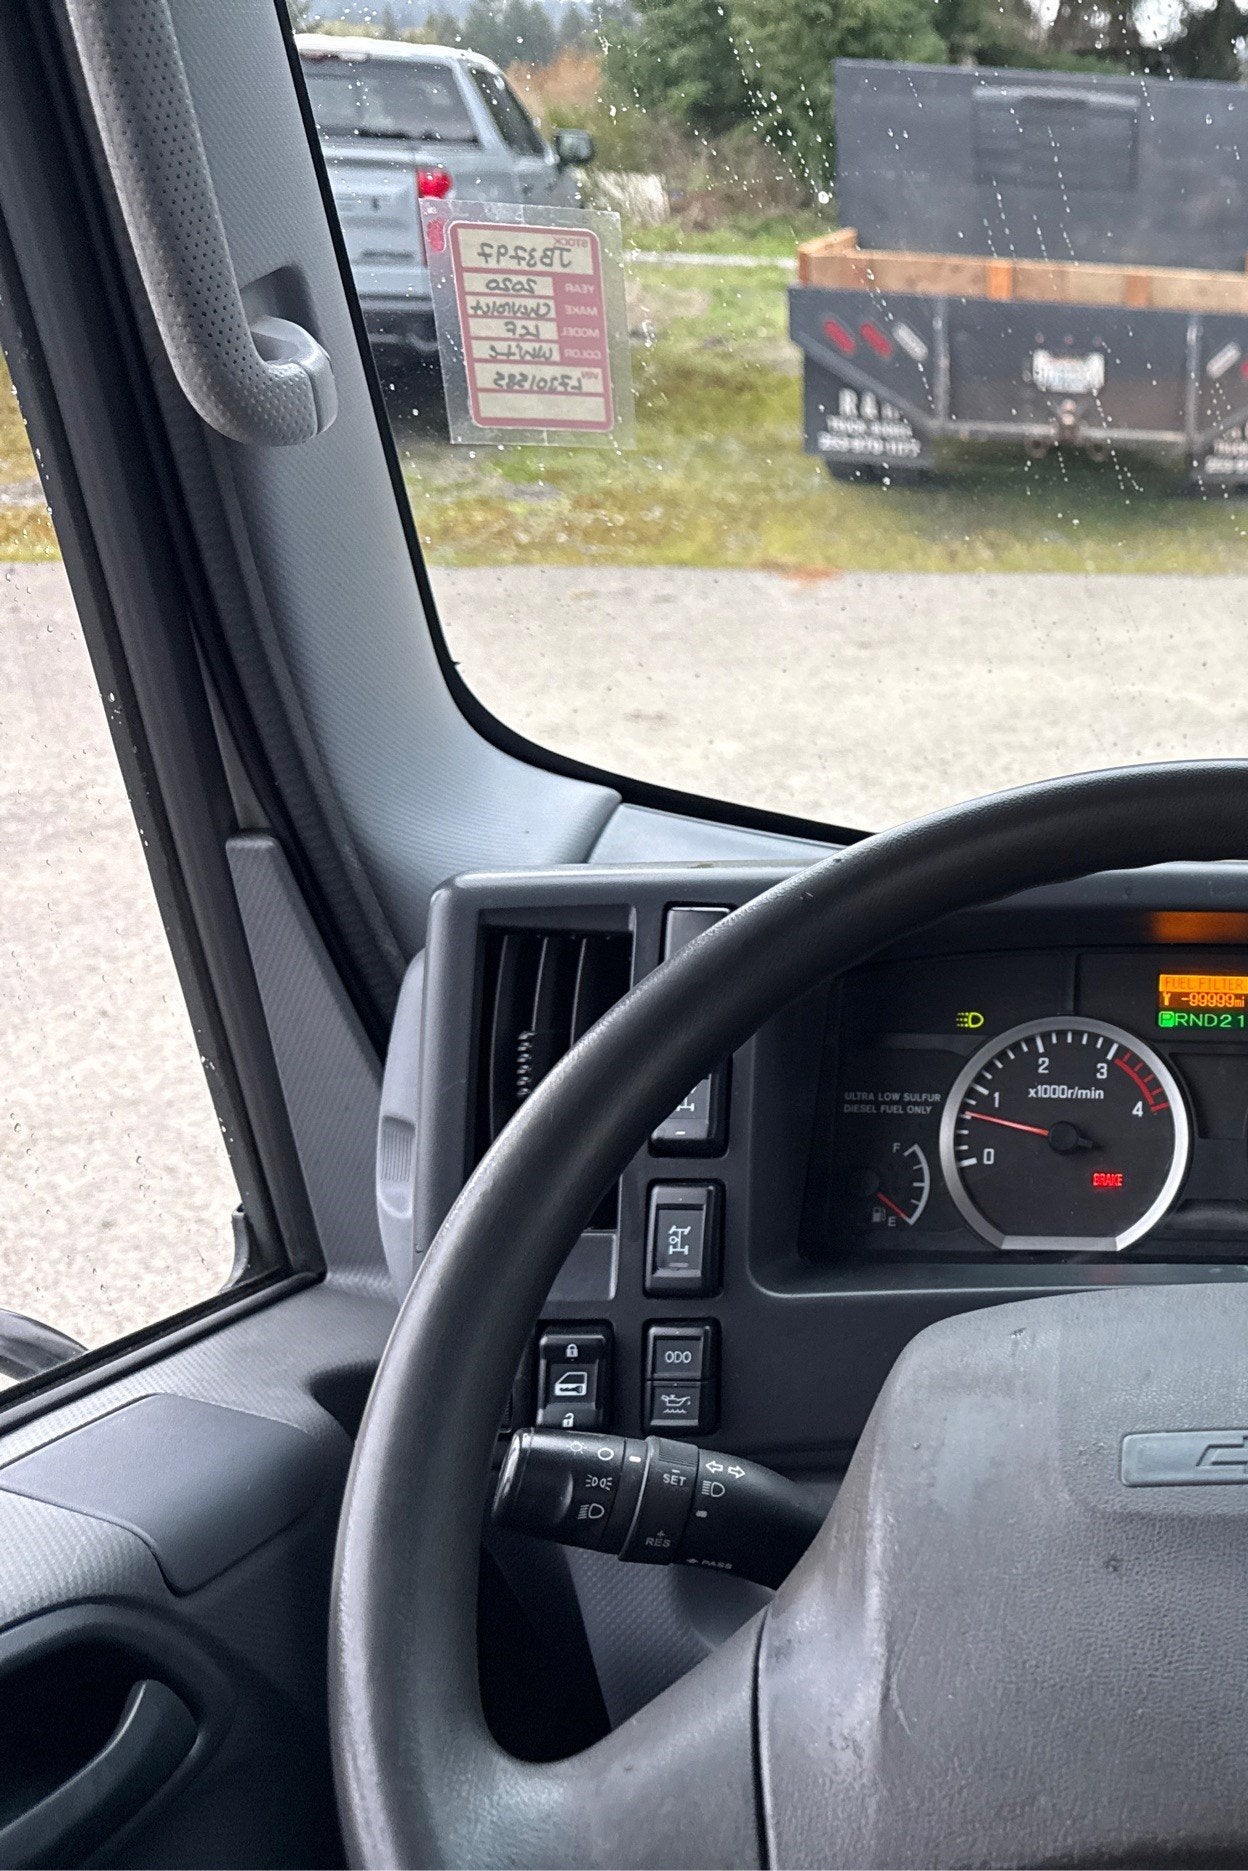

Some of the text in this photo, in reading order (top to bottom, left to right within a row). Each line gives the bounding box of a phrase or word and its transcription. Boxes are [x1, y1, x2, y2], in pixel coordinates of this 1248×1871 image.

[1165, 977, 1243, 991] FUEL FILTER
[1038, 1057, 1049, 1073] 2
[1096, 1063, 1108, 1079] 3
[844, 1092, 941, 1102] ULTRA LOW SULFUR
[1028, 1085, 1104, 1099] x1000r/min
[993, 1092, 1000, 1108] 1
[844, 1104, 932, 1114] DIESEL FUEL ONLY
[1131, 1101, 1143, 1117] 4
[892, 1143, 901, 1153] F
[983, 1148, 995, 1165] 0
[1093, 1173, 1123, 1187] BRAKE
[887, 1216, 897, 1227] E
[665, 1351, 692, 1363] ODO
[663, 1473, 686, 1486] SET
[645, 1537, 671, 1548] RES
